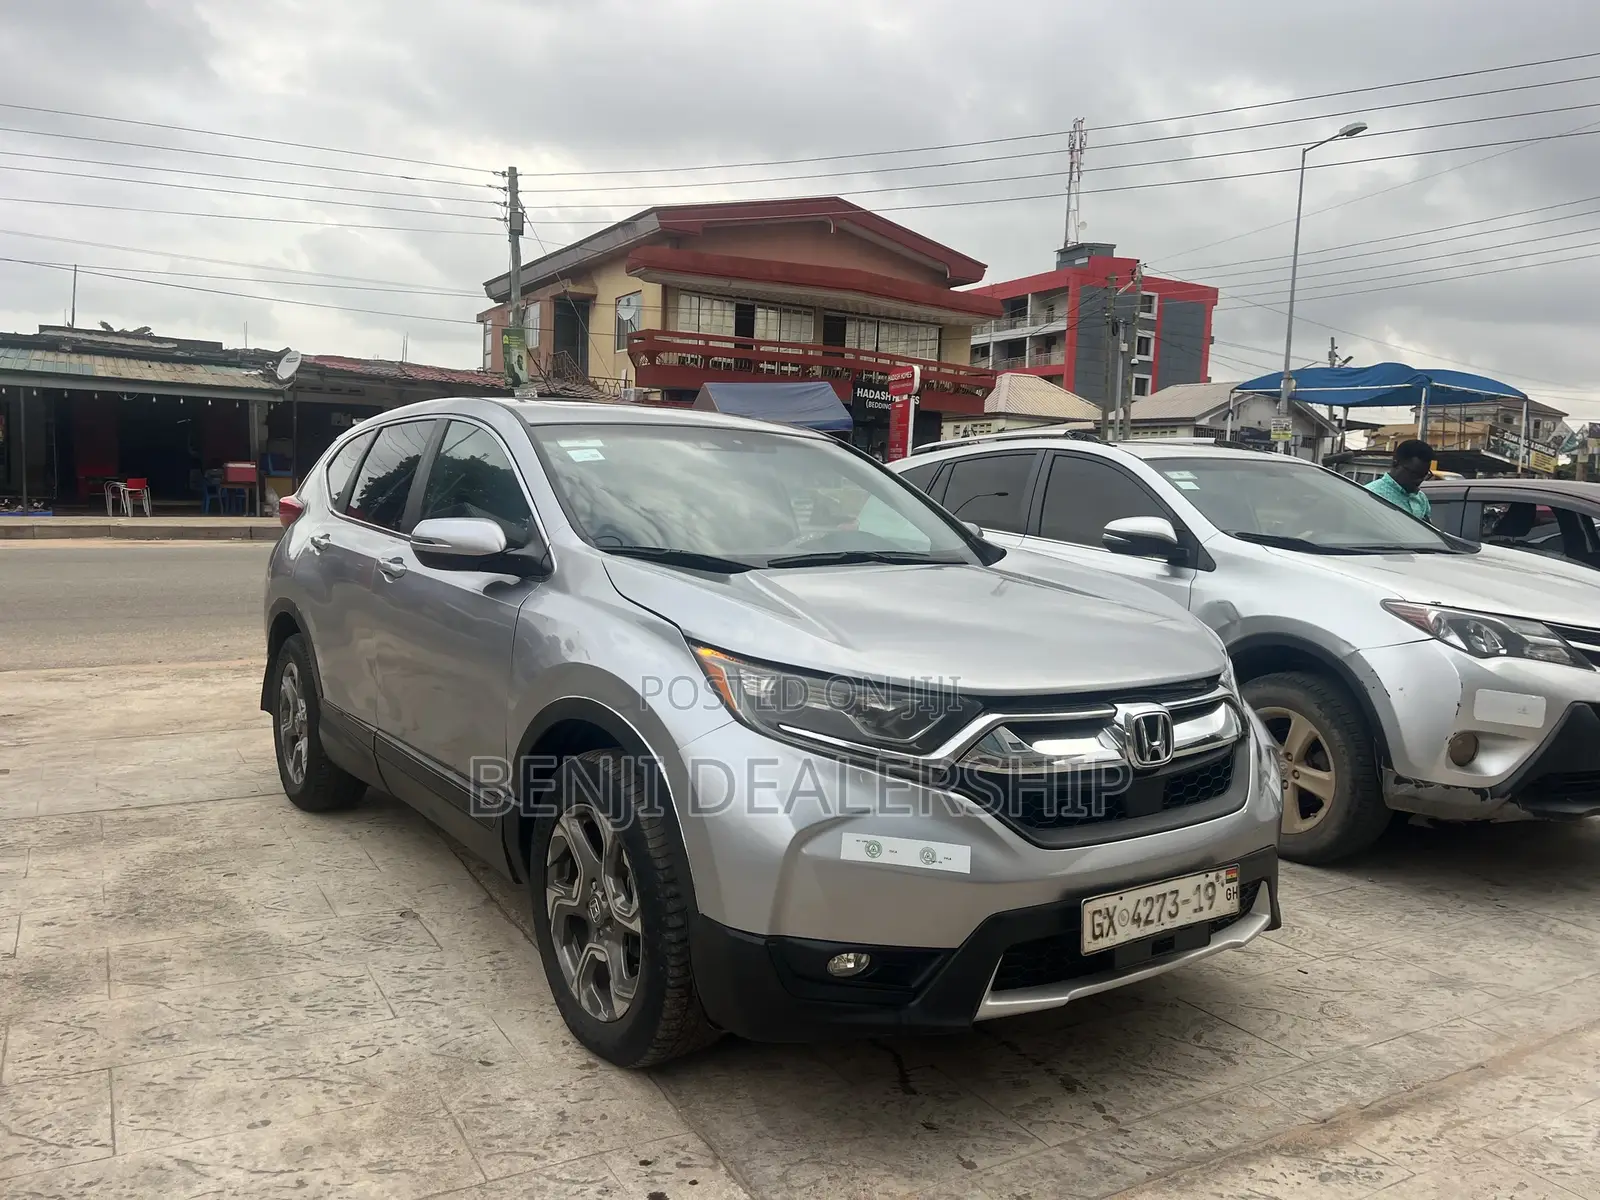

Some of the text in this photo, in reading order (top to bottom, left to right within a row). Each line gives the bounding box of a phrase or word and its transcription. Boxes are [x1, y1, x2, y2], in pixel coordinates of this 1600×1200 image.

[857, 388, 891, 401] HADASH
[1225, 887, 1239, 901] GH
[1091, 905, 1118, 941] GX
